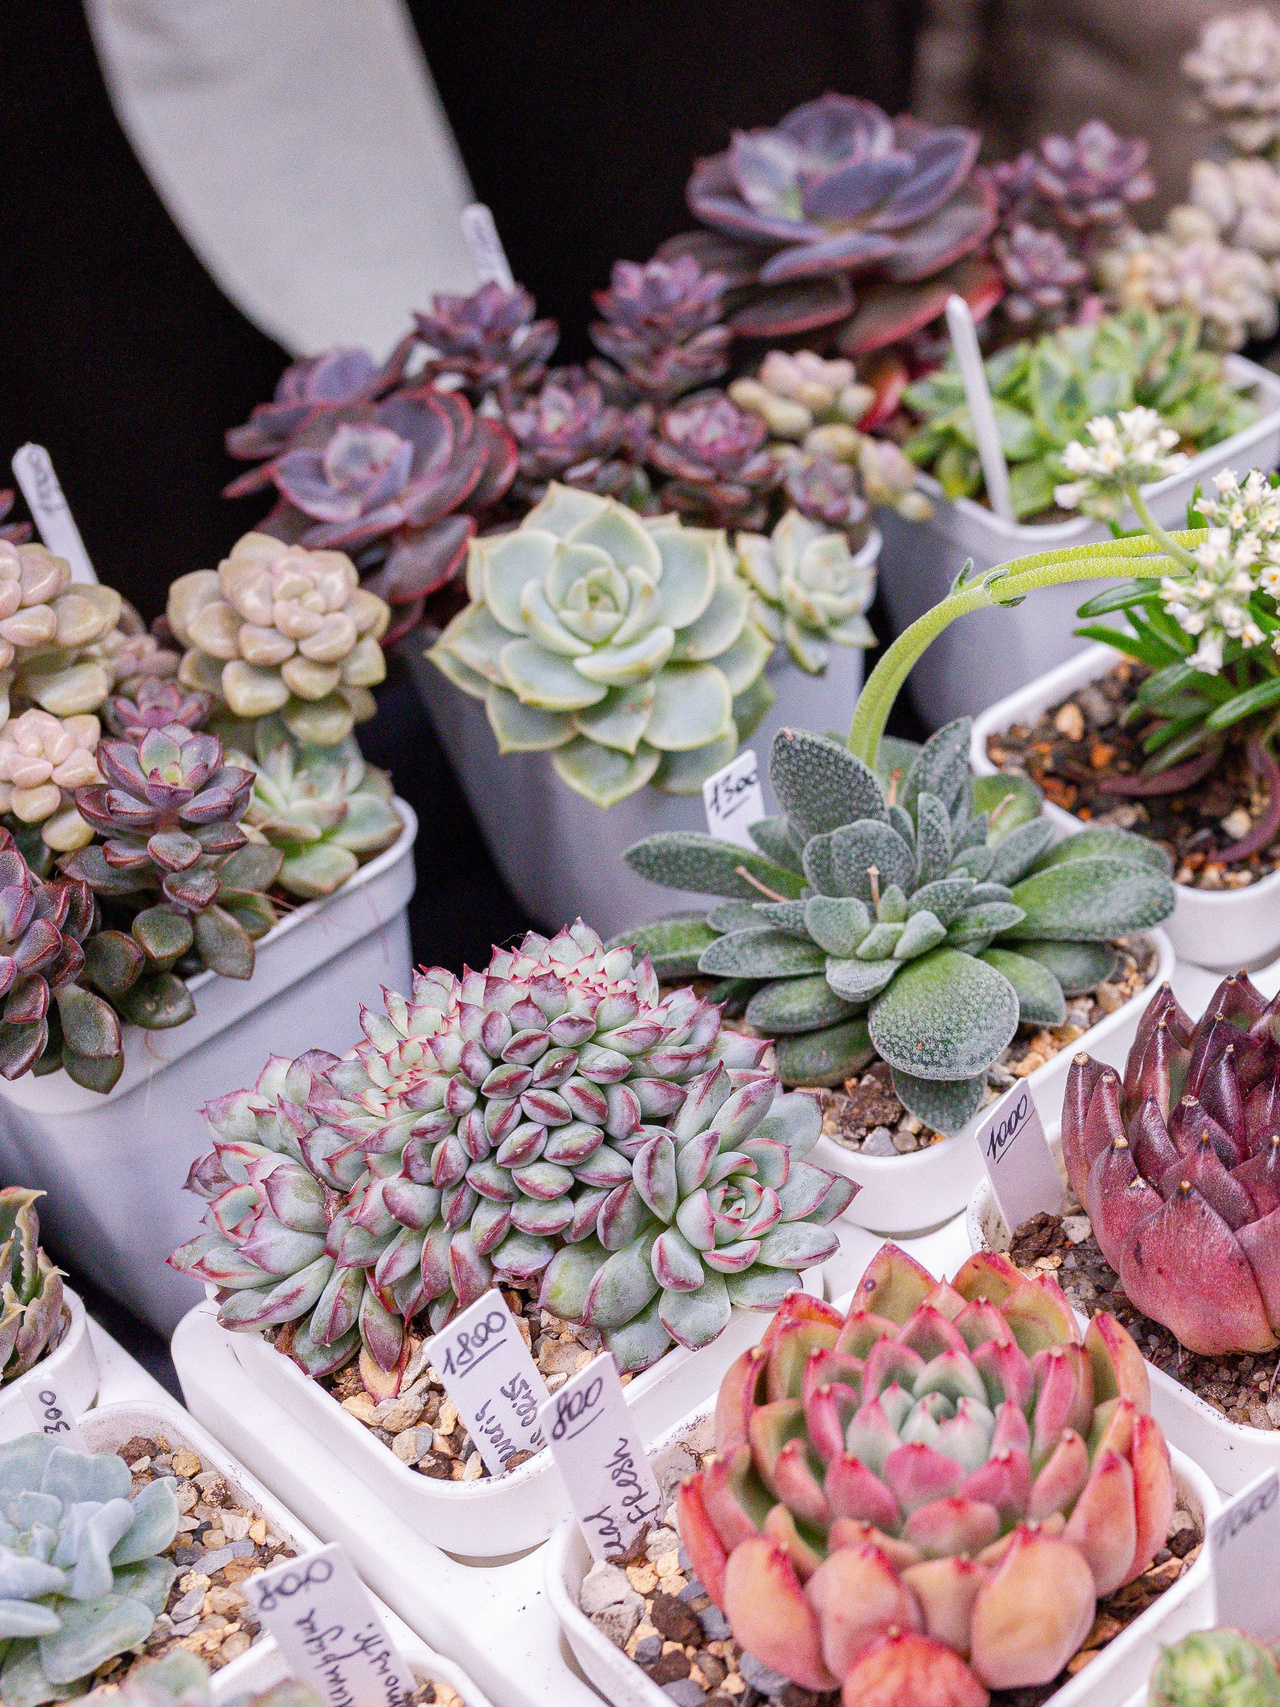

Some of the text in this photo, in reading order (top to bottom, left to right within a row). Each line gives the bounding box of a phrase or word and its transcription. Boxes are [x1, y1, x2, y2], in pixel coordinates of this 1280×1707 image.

[986, 1093, 1029, 1160] 1000
[442, 1310, 508, 1376] 1800
[38, 1390, 71, 1434] 300
[551, 1377, 603, 1441] 800
